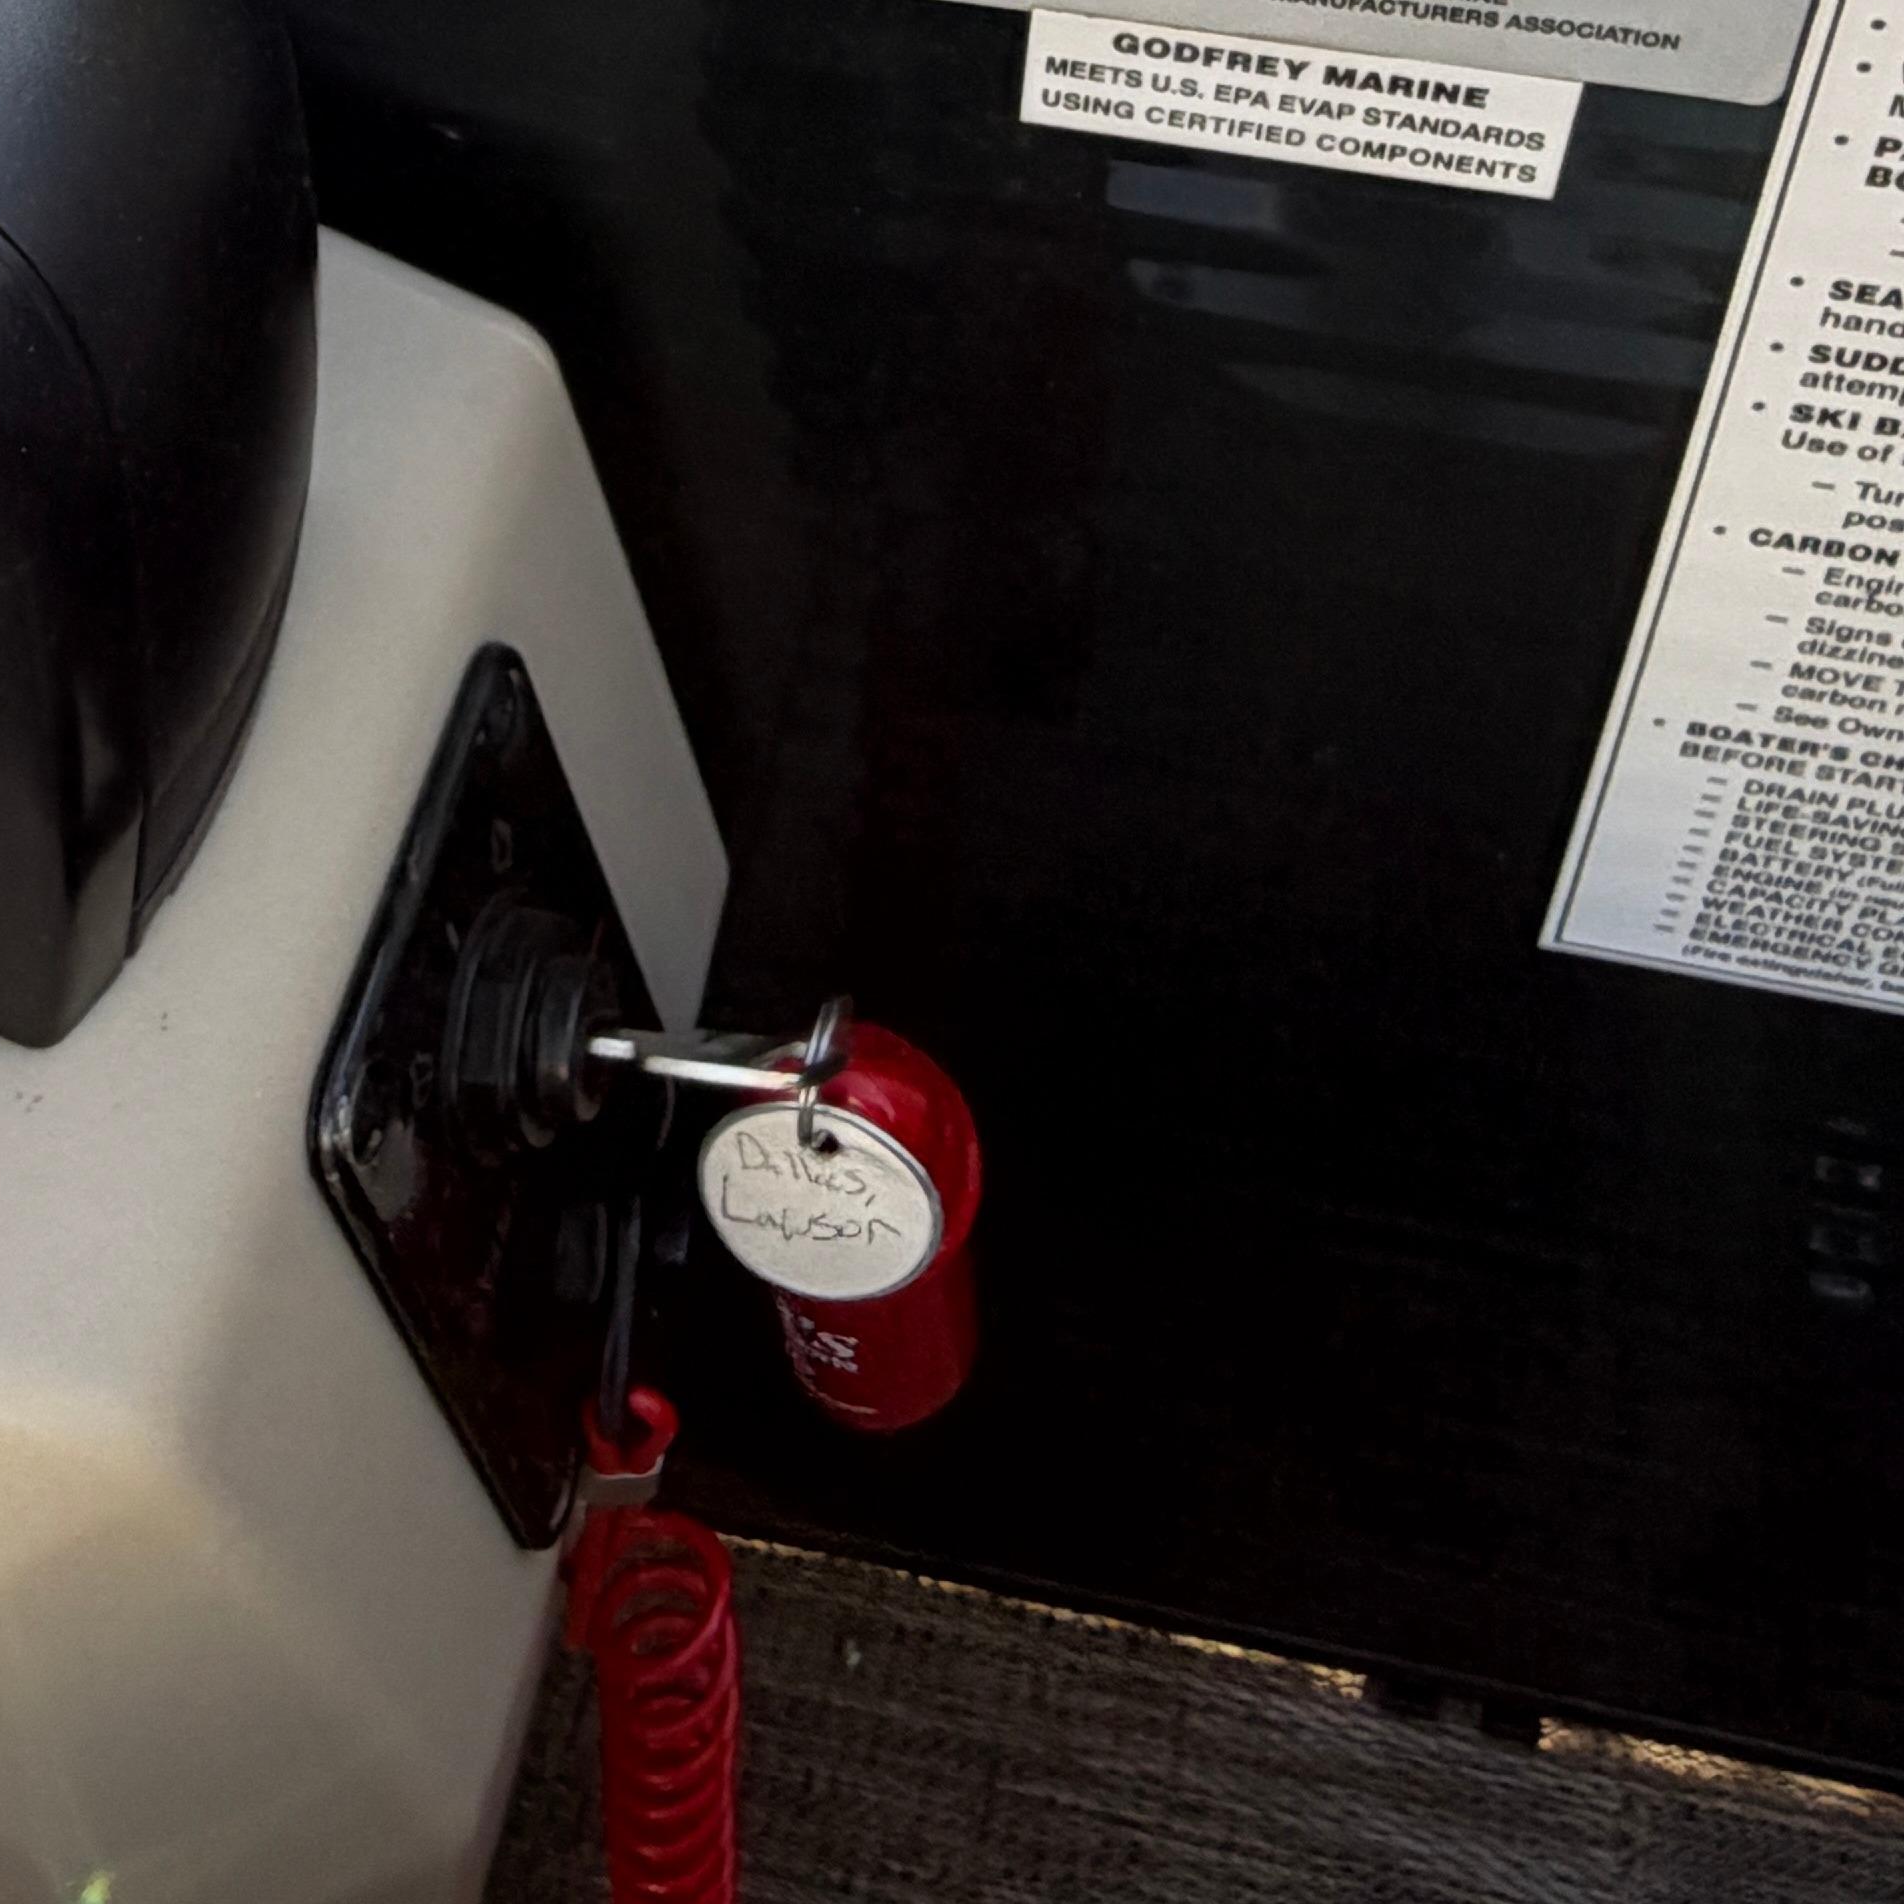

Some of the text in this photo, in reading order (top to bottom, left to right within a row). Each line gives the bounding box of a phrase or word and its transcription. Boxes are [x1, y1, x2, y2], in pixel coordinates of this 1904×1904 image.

[1112, 32, 1490, 110] GODFREY MARINE
[1504, 13, 1682, 51] ASSOCIATION
[1041, 87, 1537, 184] USING CERTIFIED COMPONENTS
[1044, 55, 1546, 152] MEETS U.S. EPA EVAP STANDARDS
[1749, 527, 1901, 568] CARBON
